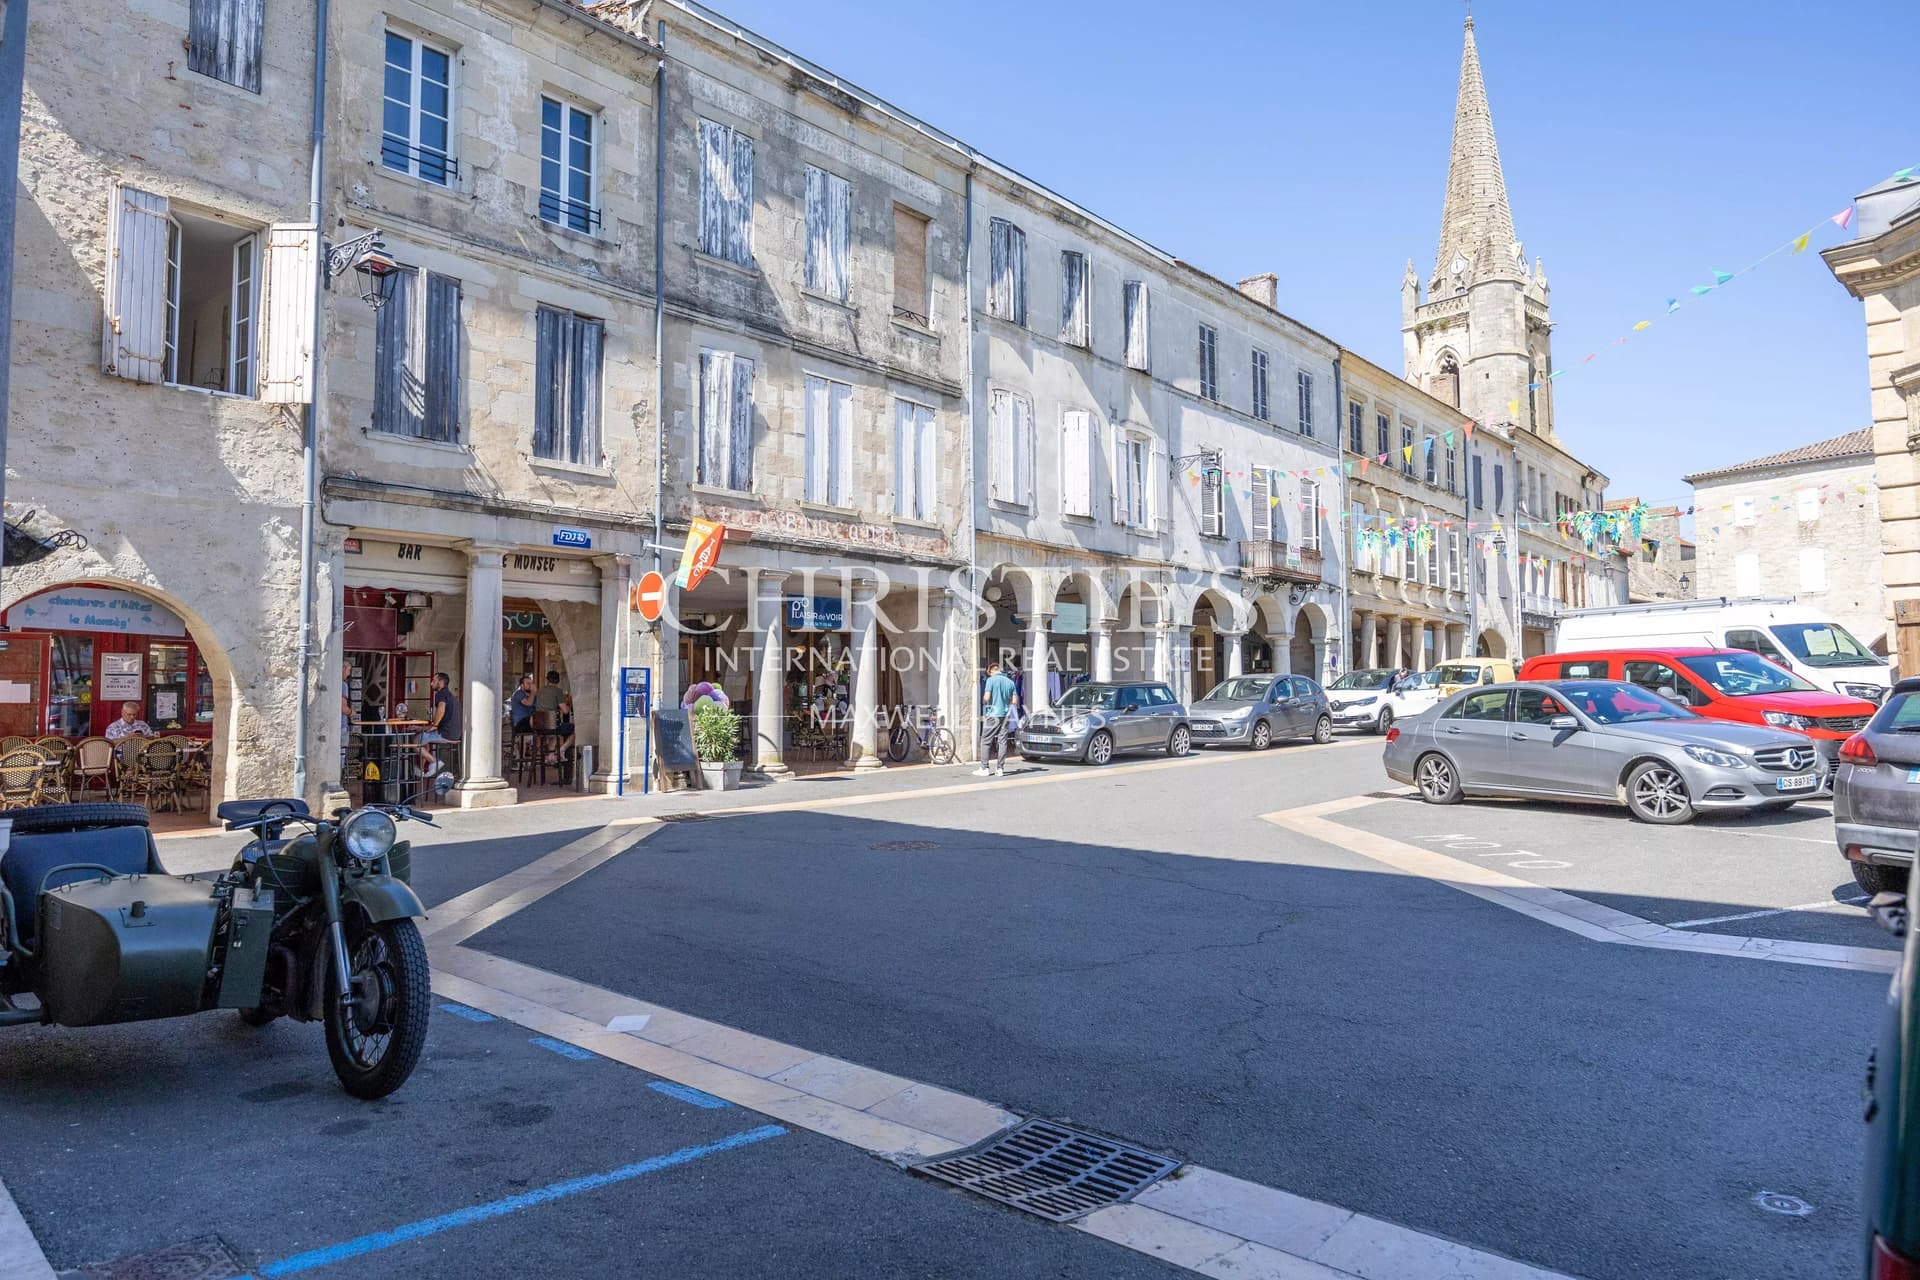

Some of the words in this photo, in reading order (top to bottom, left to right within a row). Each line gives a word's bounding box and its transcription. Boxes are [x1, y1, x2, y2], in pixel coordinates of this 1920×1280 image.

[560, 531, 577, 541] FDJ
[398, 543, 422, 561] BAR
[693, 538, 716, 577] TABAC
[69, 614, 80, 625] le
[825, 613, 843, 622] VOIR
